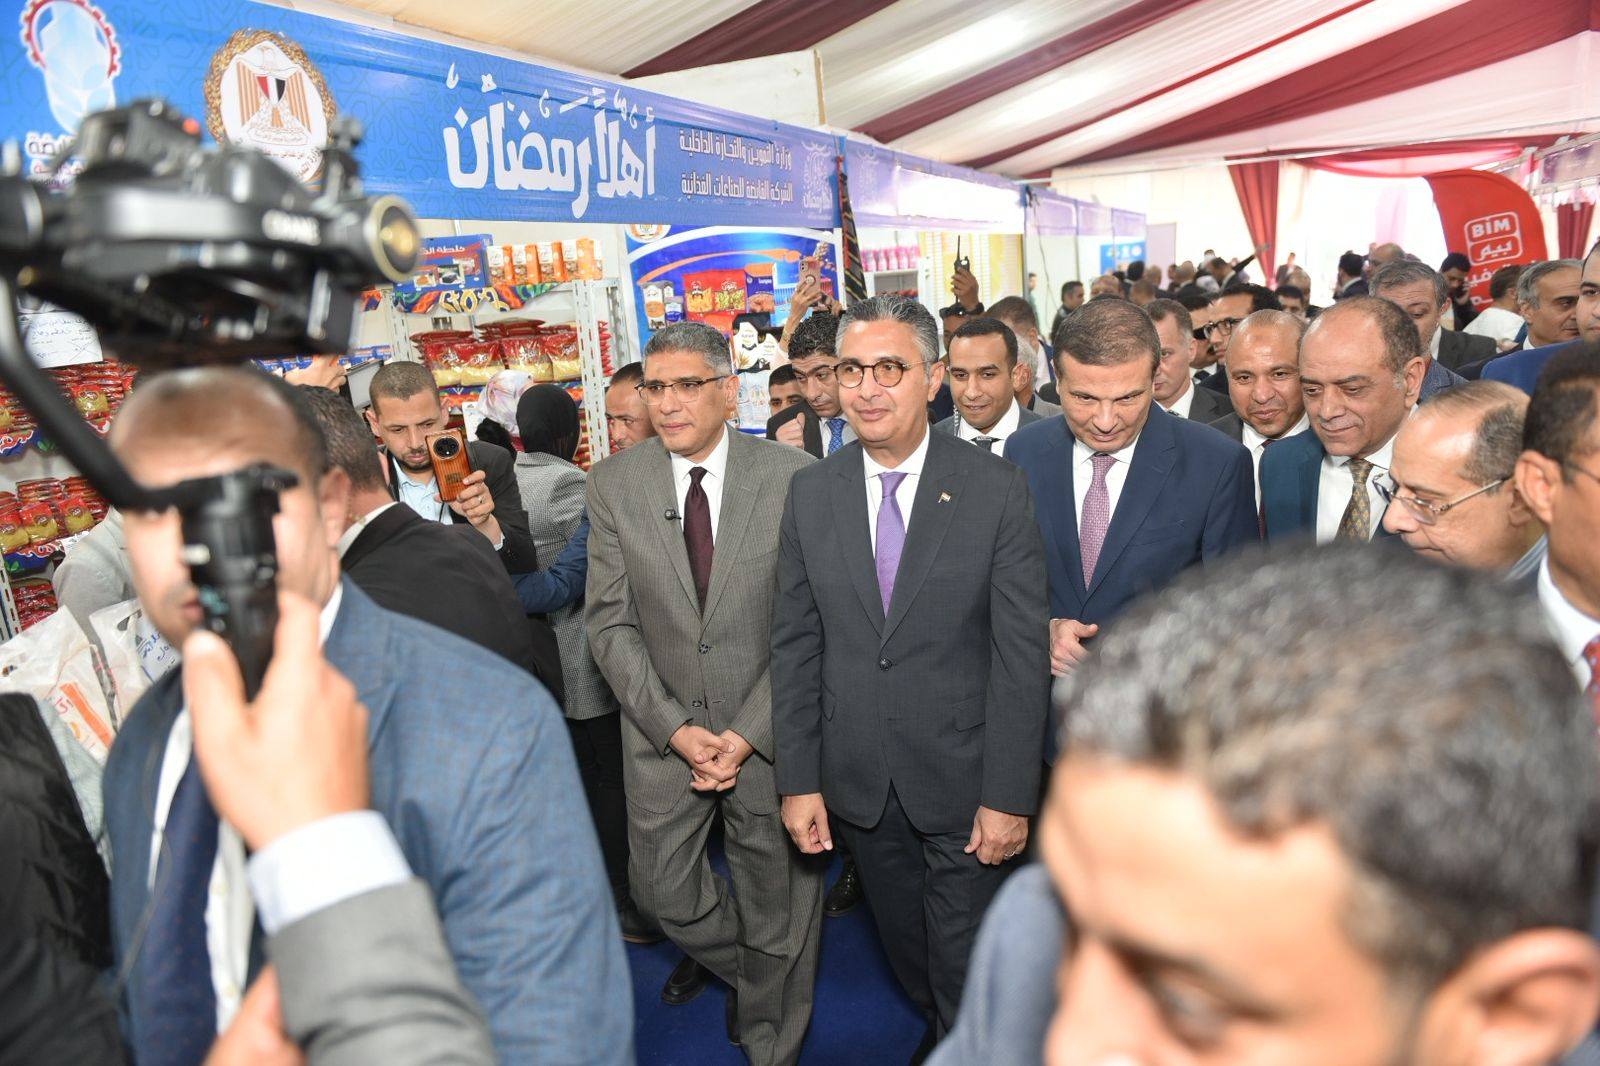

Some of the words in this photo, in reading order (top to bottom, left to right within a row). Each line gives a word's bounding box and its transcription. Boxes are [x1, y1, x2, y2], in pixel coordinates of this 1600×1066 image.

[680, 128, 714, 157] الداخلية
[715, 133, 747, 164] والتجارة
[748, 142, 775, 167] التموين
[775, 144, 792, 171] وزارة
[681, 171, 712, 200] الغذائية
[713, 174, 745, 198] للصناعات
[746, 178, 770, 203] القابضة
[770, 181, 793, 205] الشركة
[1471, 218, 1511, 239] BIM
[1476, 240, 1513, 261] بيم
